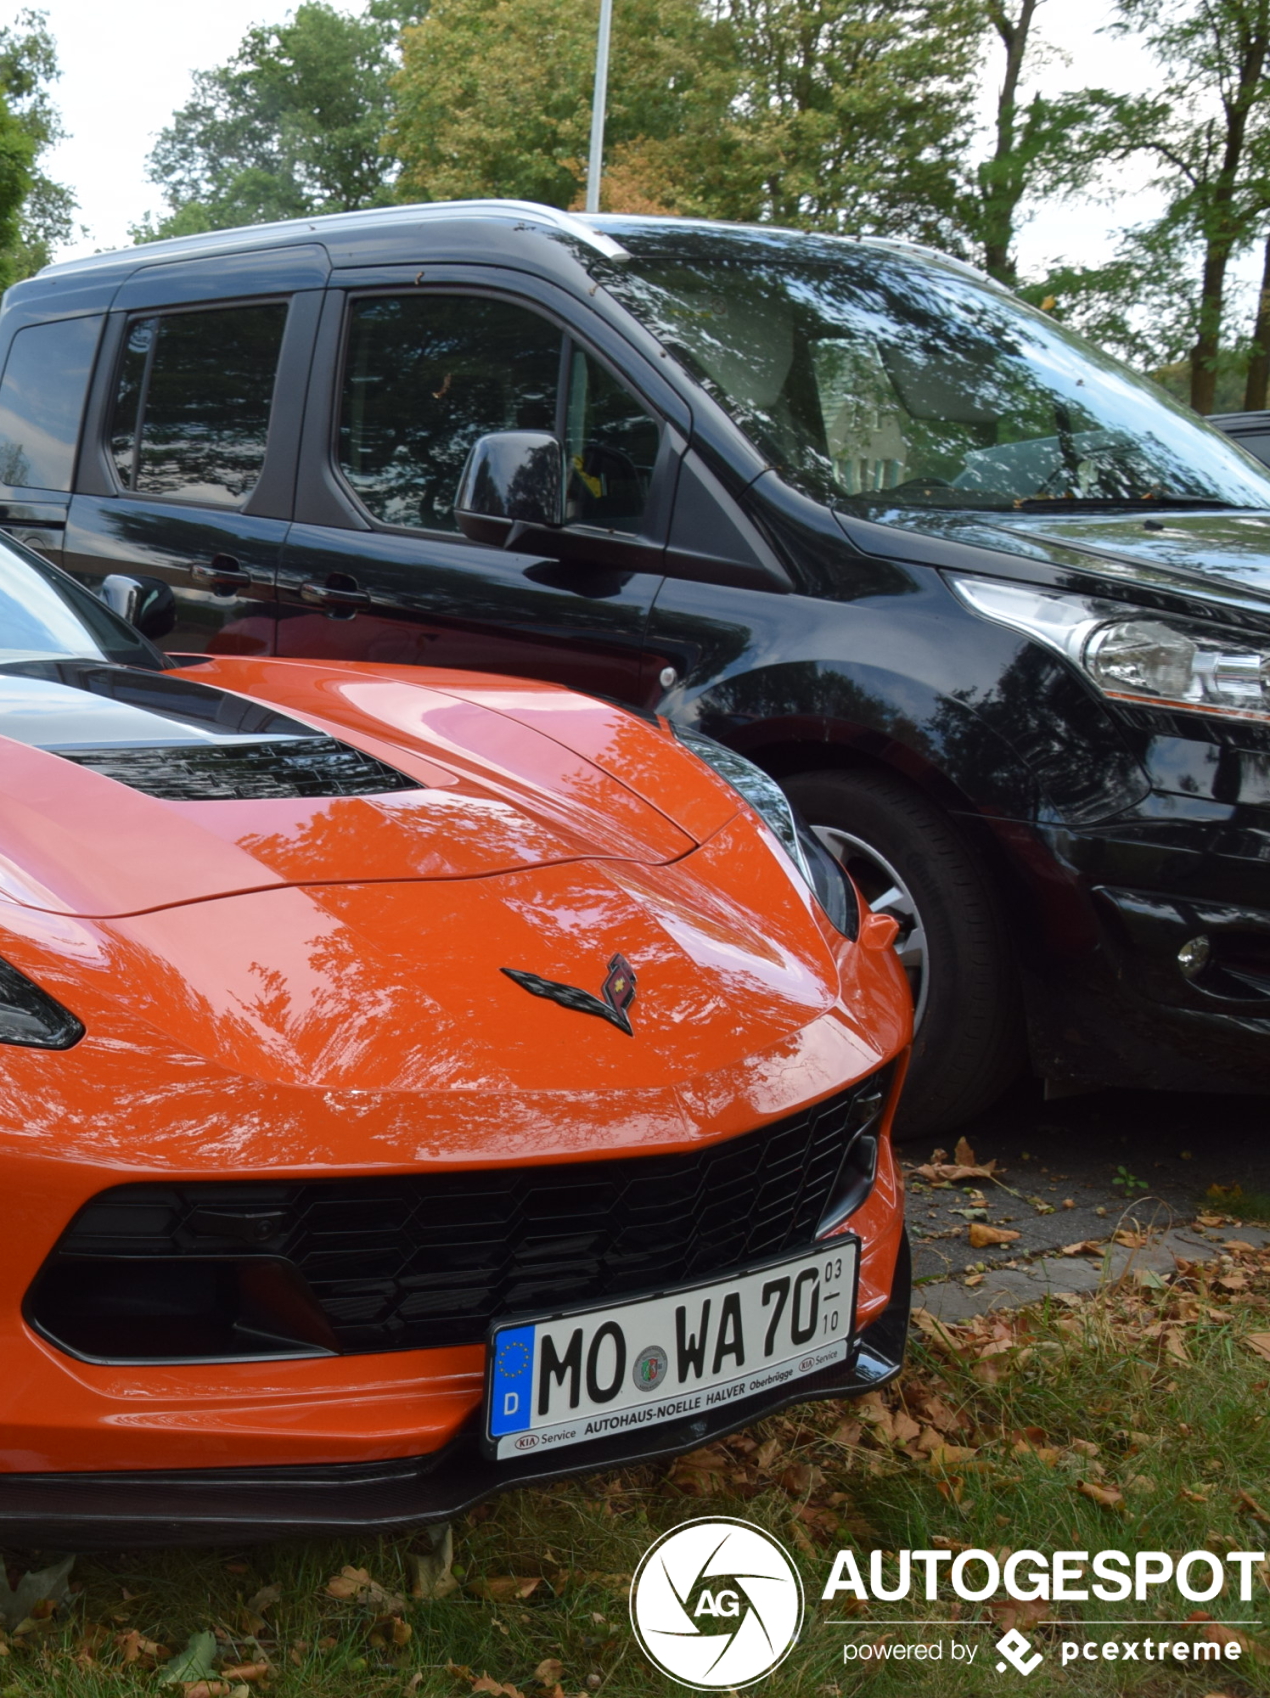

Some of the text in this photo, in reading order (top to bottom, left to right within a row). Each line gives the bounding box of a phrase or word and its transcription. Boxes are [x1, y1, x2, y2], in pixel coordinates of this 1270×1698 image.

[824, 1258, 843, 1283] 03
[823, 1310, 839, 1335] 10
[537, 1320, 627, 1417] MO
[675, 1291, 745, 1384] WA
[761, 1266, 821, 1358] 70
[503, 1392, 520, 1416] D
[518, 1350, 838, 1448] KIA Service AUTOHAUS-NOELLE HALVER Oberbrügge KIA Service
